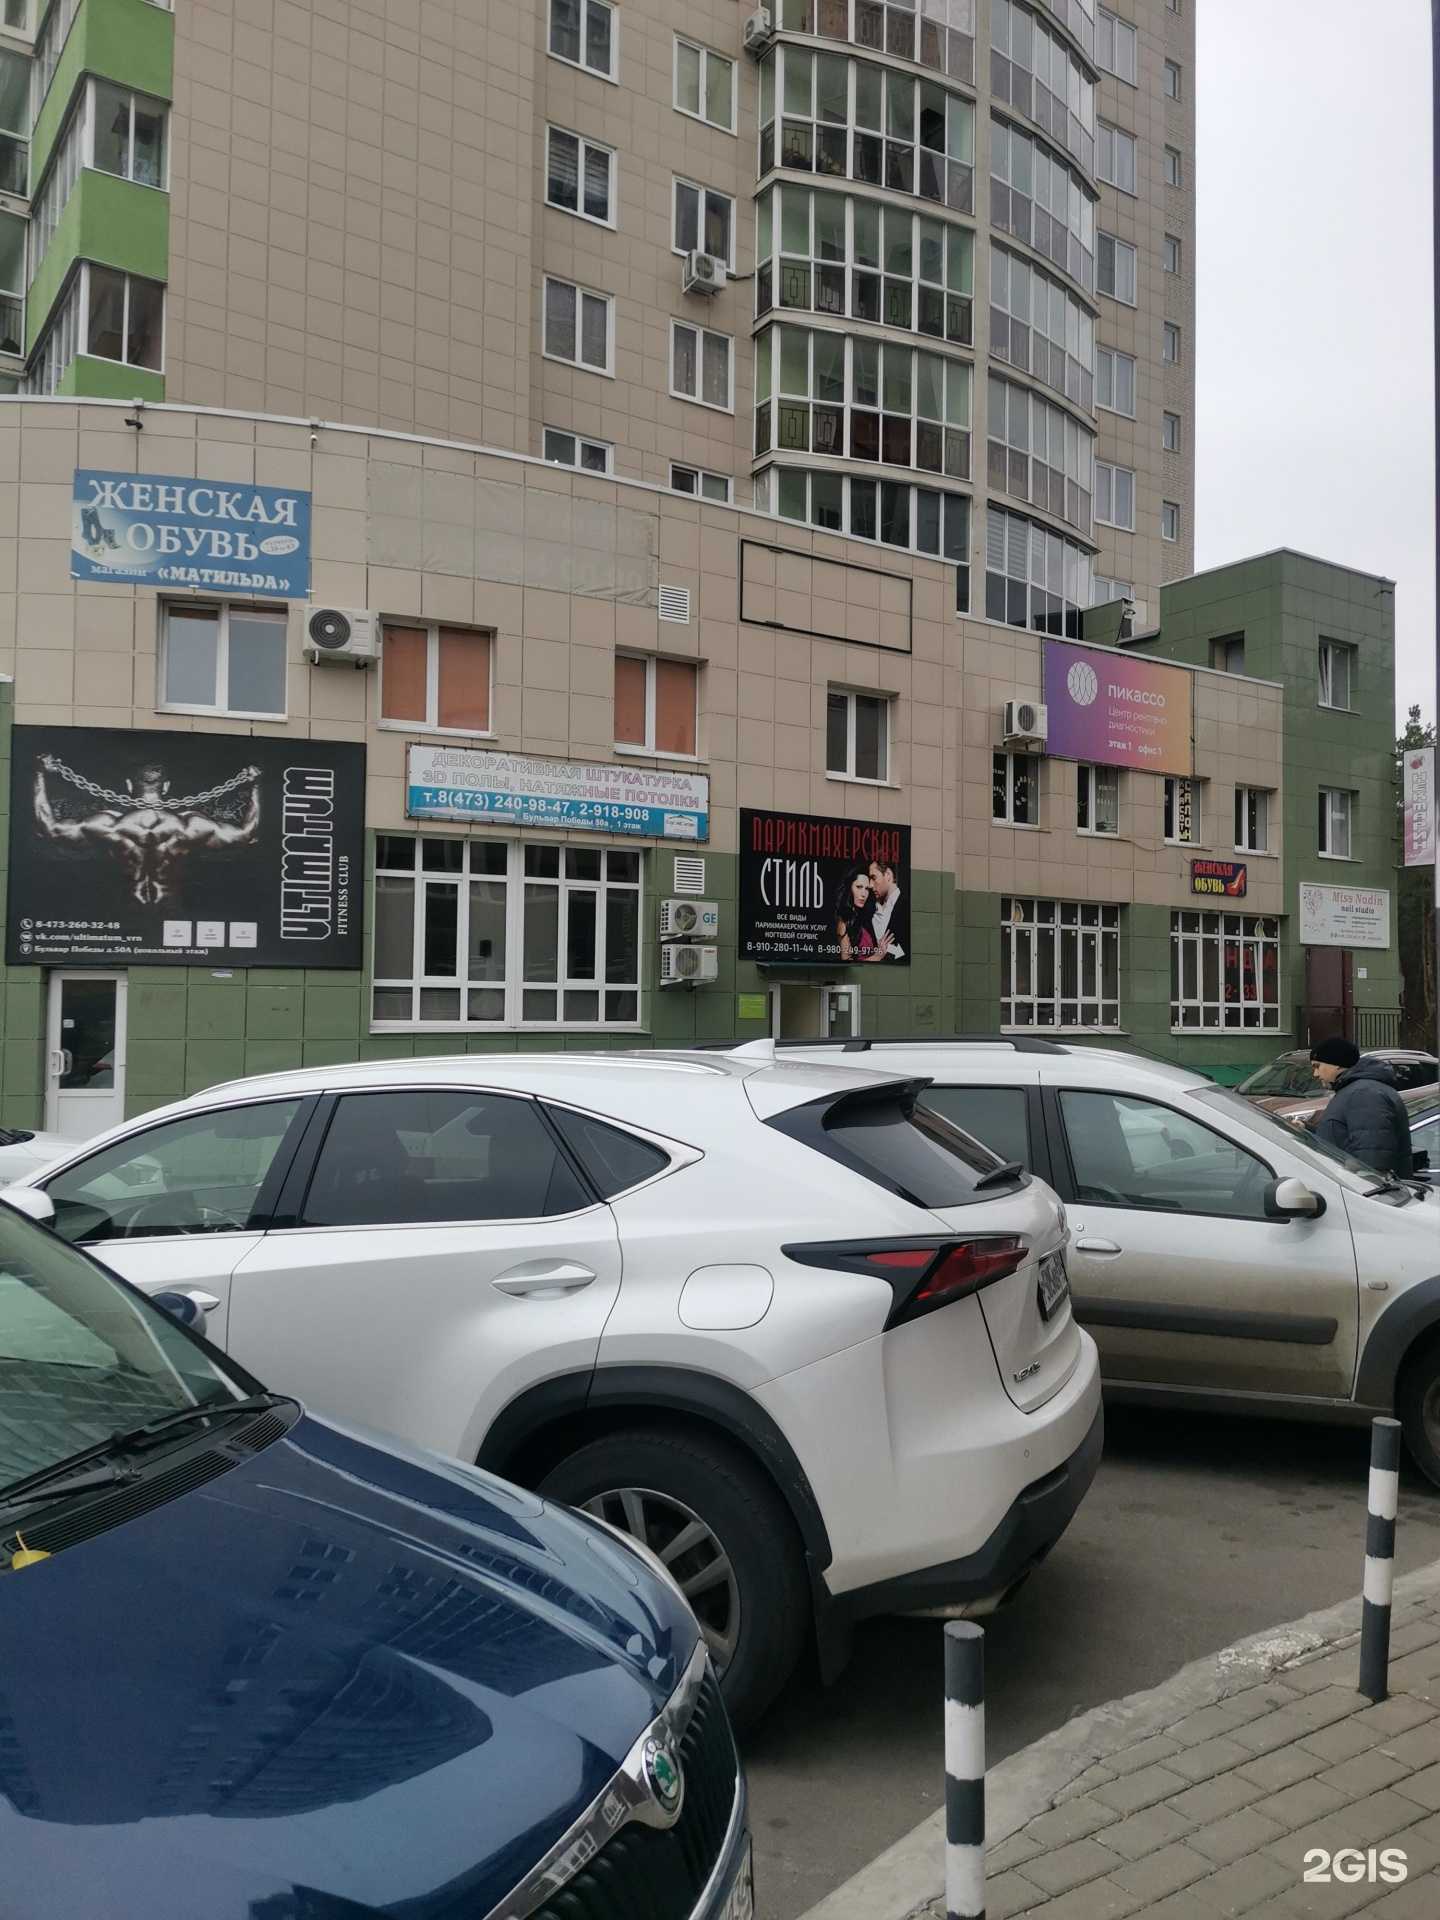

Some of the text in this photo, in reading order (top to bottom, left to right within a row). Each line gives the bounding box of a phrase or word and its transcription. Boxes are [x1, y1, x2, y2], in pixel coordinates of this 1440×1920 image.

[88, 479, 298, 527] ЖЕНСКАЯ
[126, 522, 260, 562] ОБУВЬ
[91, 564, 147, 578] магазин
[431, 751, 693, 792] ДЕКОРАТИВНАЯ ШТУКАТУРКА
[519, 778, 621, 801] НАТЯЖНЫЕ
[624, 788, 700, 809] ПОТОЛКИ
[494, 795, 575, 816] 240-98-47,
[579, 802, 650, 821] 2-918-908
[752, 815, 901, 864] ПАРИКМАХЕРСКАЯ
[760, 857, 824, 909] СТИЛЬ
[1194, 877, 1225, 894] ОБУВЬ
[337, 854, 349, 936] FITNESS CLUB
[1332, 890, 1353, 904] Miss
[776, 913, 807, 922] ВСЕ ВИДЫ
[1341, 904, 1375, 914] nail studio
[34, 920, 121, 930] 8-473-260-32-48
[755, 921, 827, 932] ПАРИКМАХЕРСКИХ УСЛУГ
[764, 931, 819, 940] НОГТЕВОЙ СЕРВИС
[746, 941, 814, 953] 8-910-280-11-44
